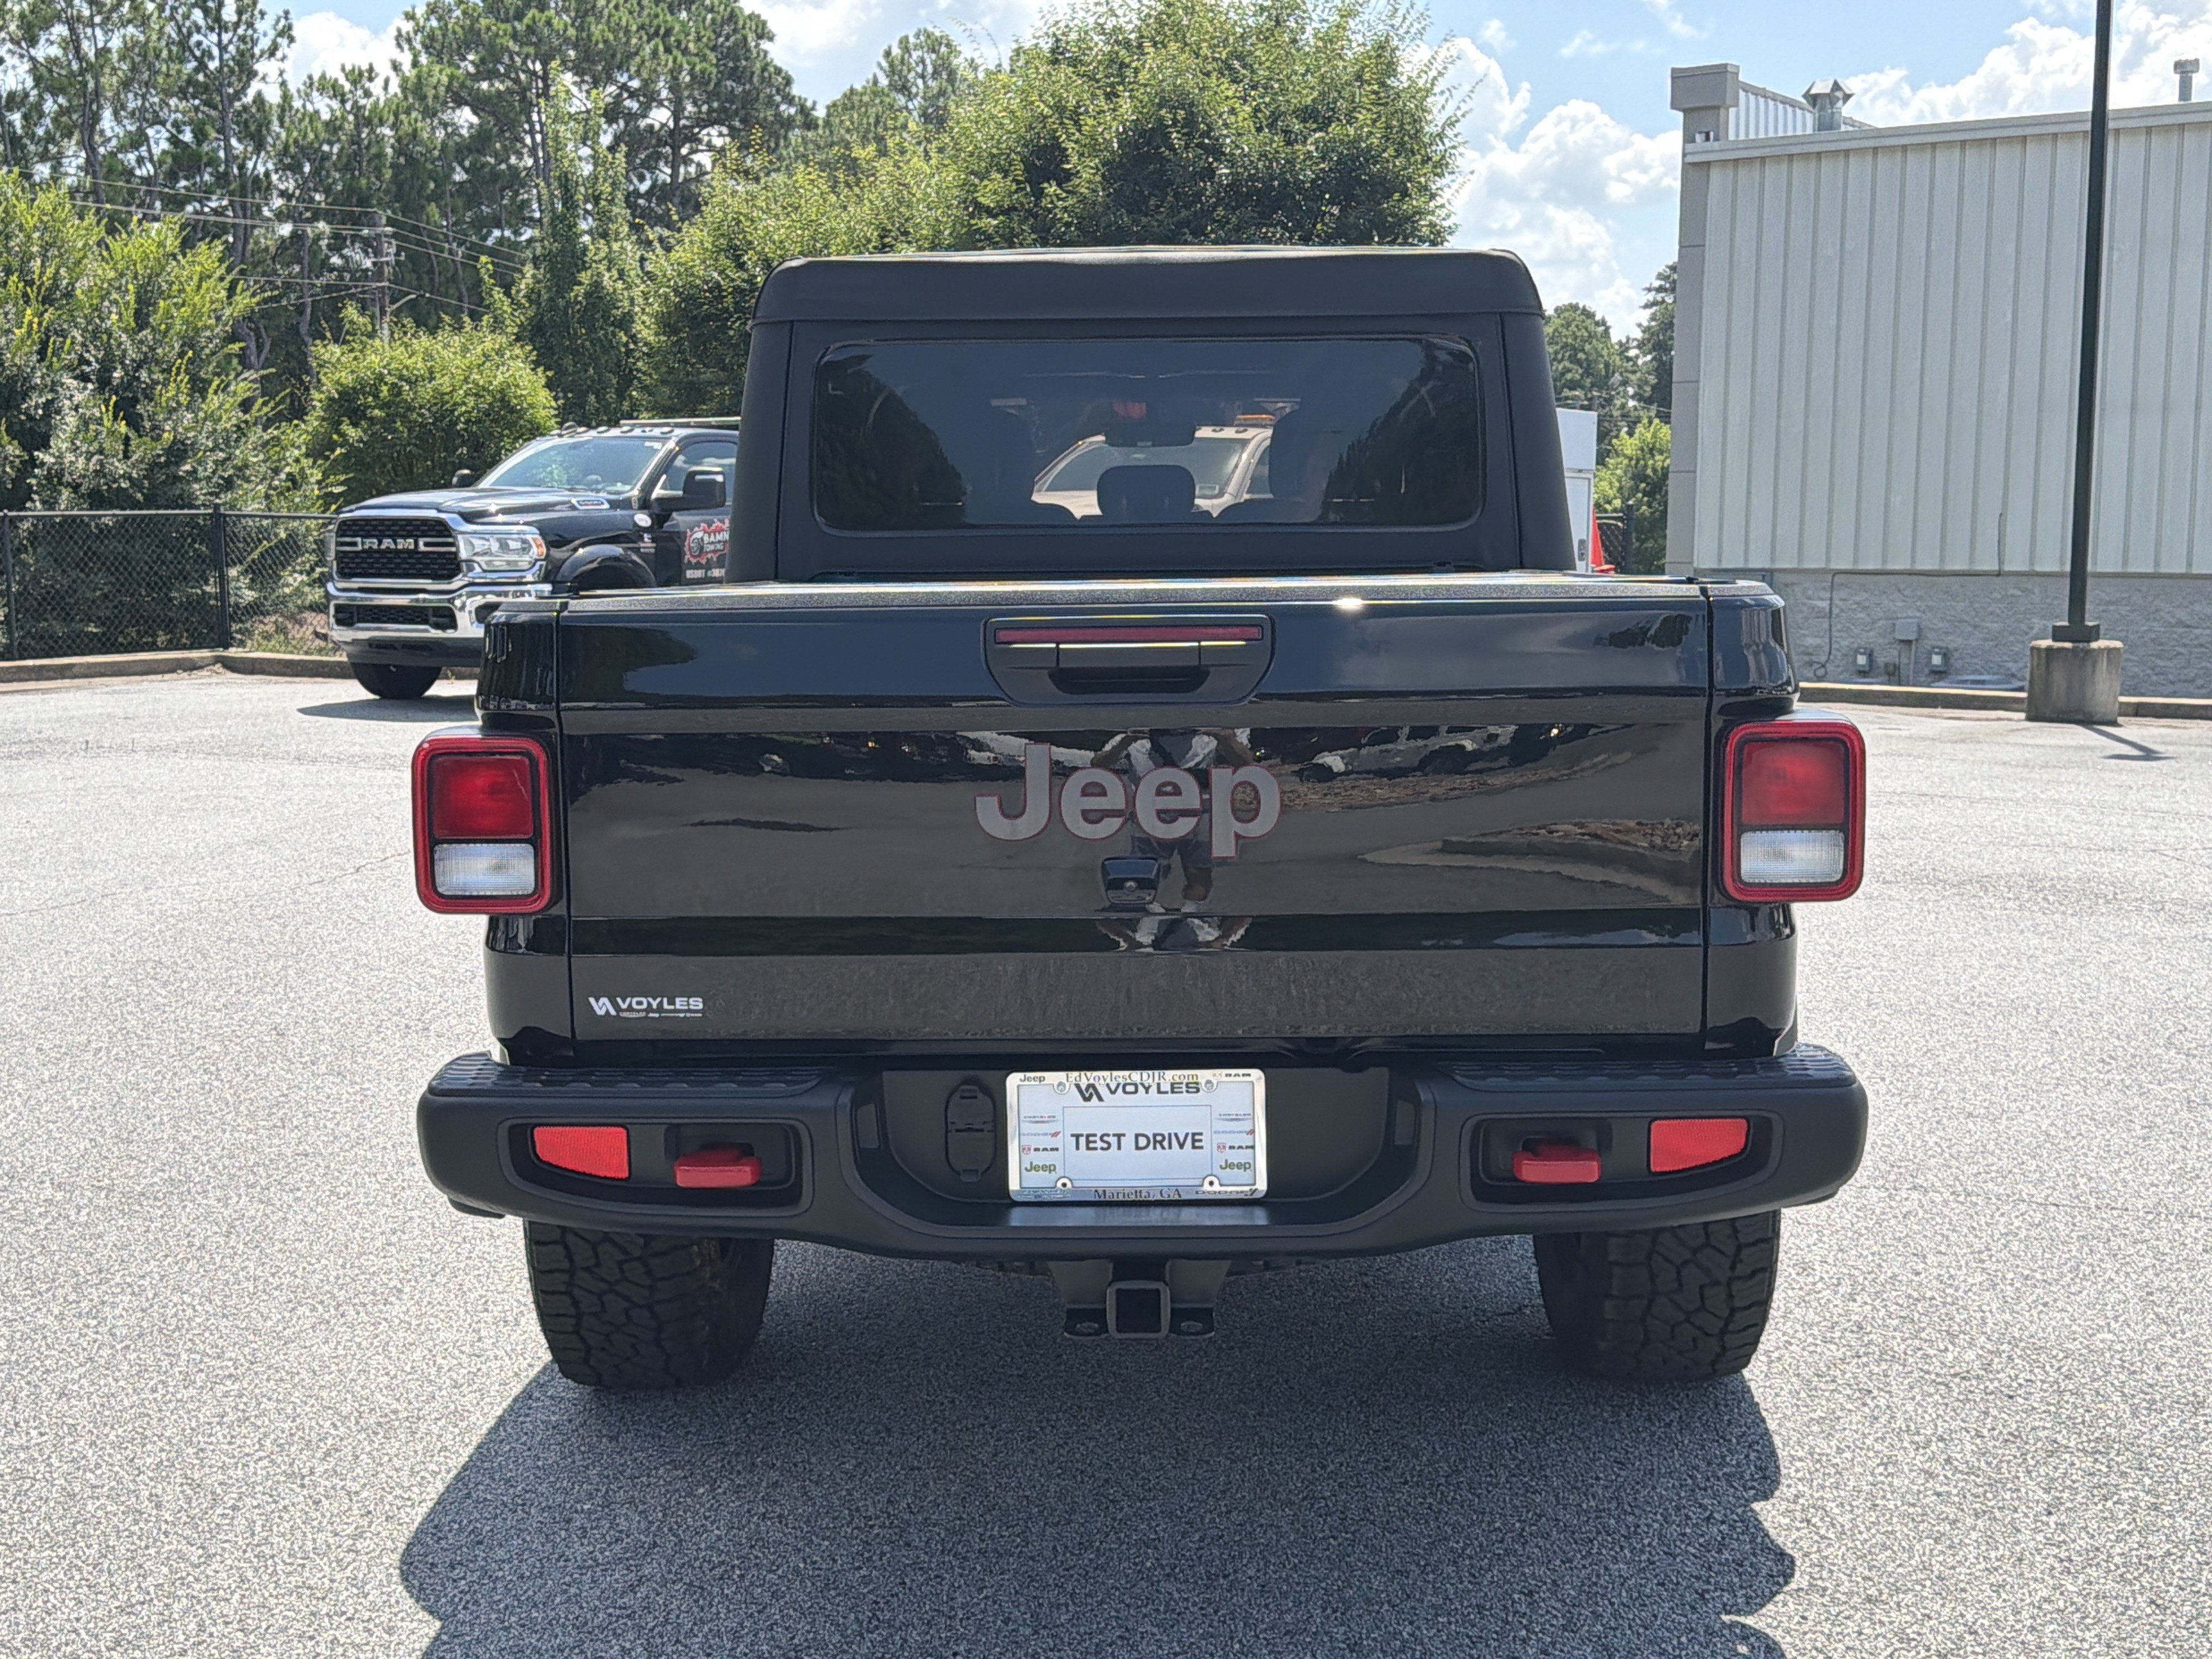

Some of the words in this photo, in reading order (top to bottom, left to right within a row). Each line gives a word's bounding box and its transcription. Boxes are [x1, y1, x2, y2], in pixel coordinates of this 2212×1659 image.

[363, 538, 415, 549] RAM
[975, 742, 1281, 859] Jeep
[616, 997, 704, 1009] VOYLES
[1019, 1074, 1046, 1084] Jeep
[1065, 1071, 1199, 1085] EdVoylesCDJR.com
[1106, 1082, 1201, 1094] VOYLES
[1070, 1132, 1126, 1151] TEST
[1134, 1132, 1204, 1151] DRIVE
[1024, 1161, 1057, 1174] Jeep
[1219, 1159, 1251, 1172] Jeep
[1093, 1188, 1156, 1199] Marietta,
[1159, 1187, 1182, 1199] GA
